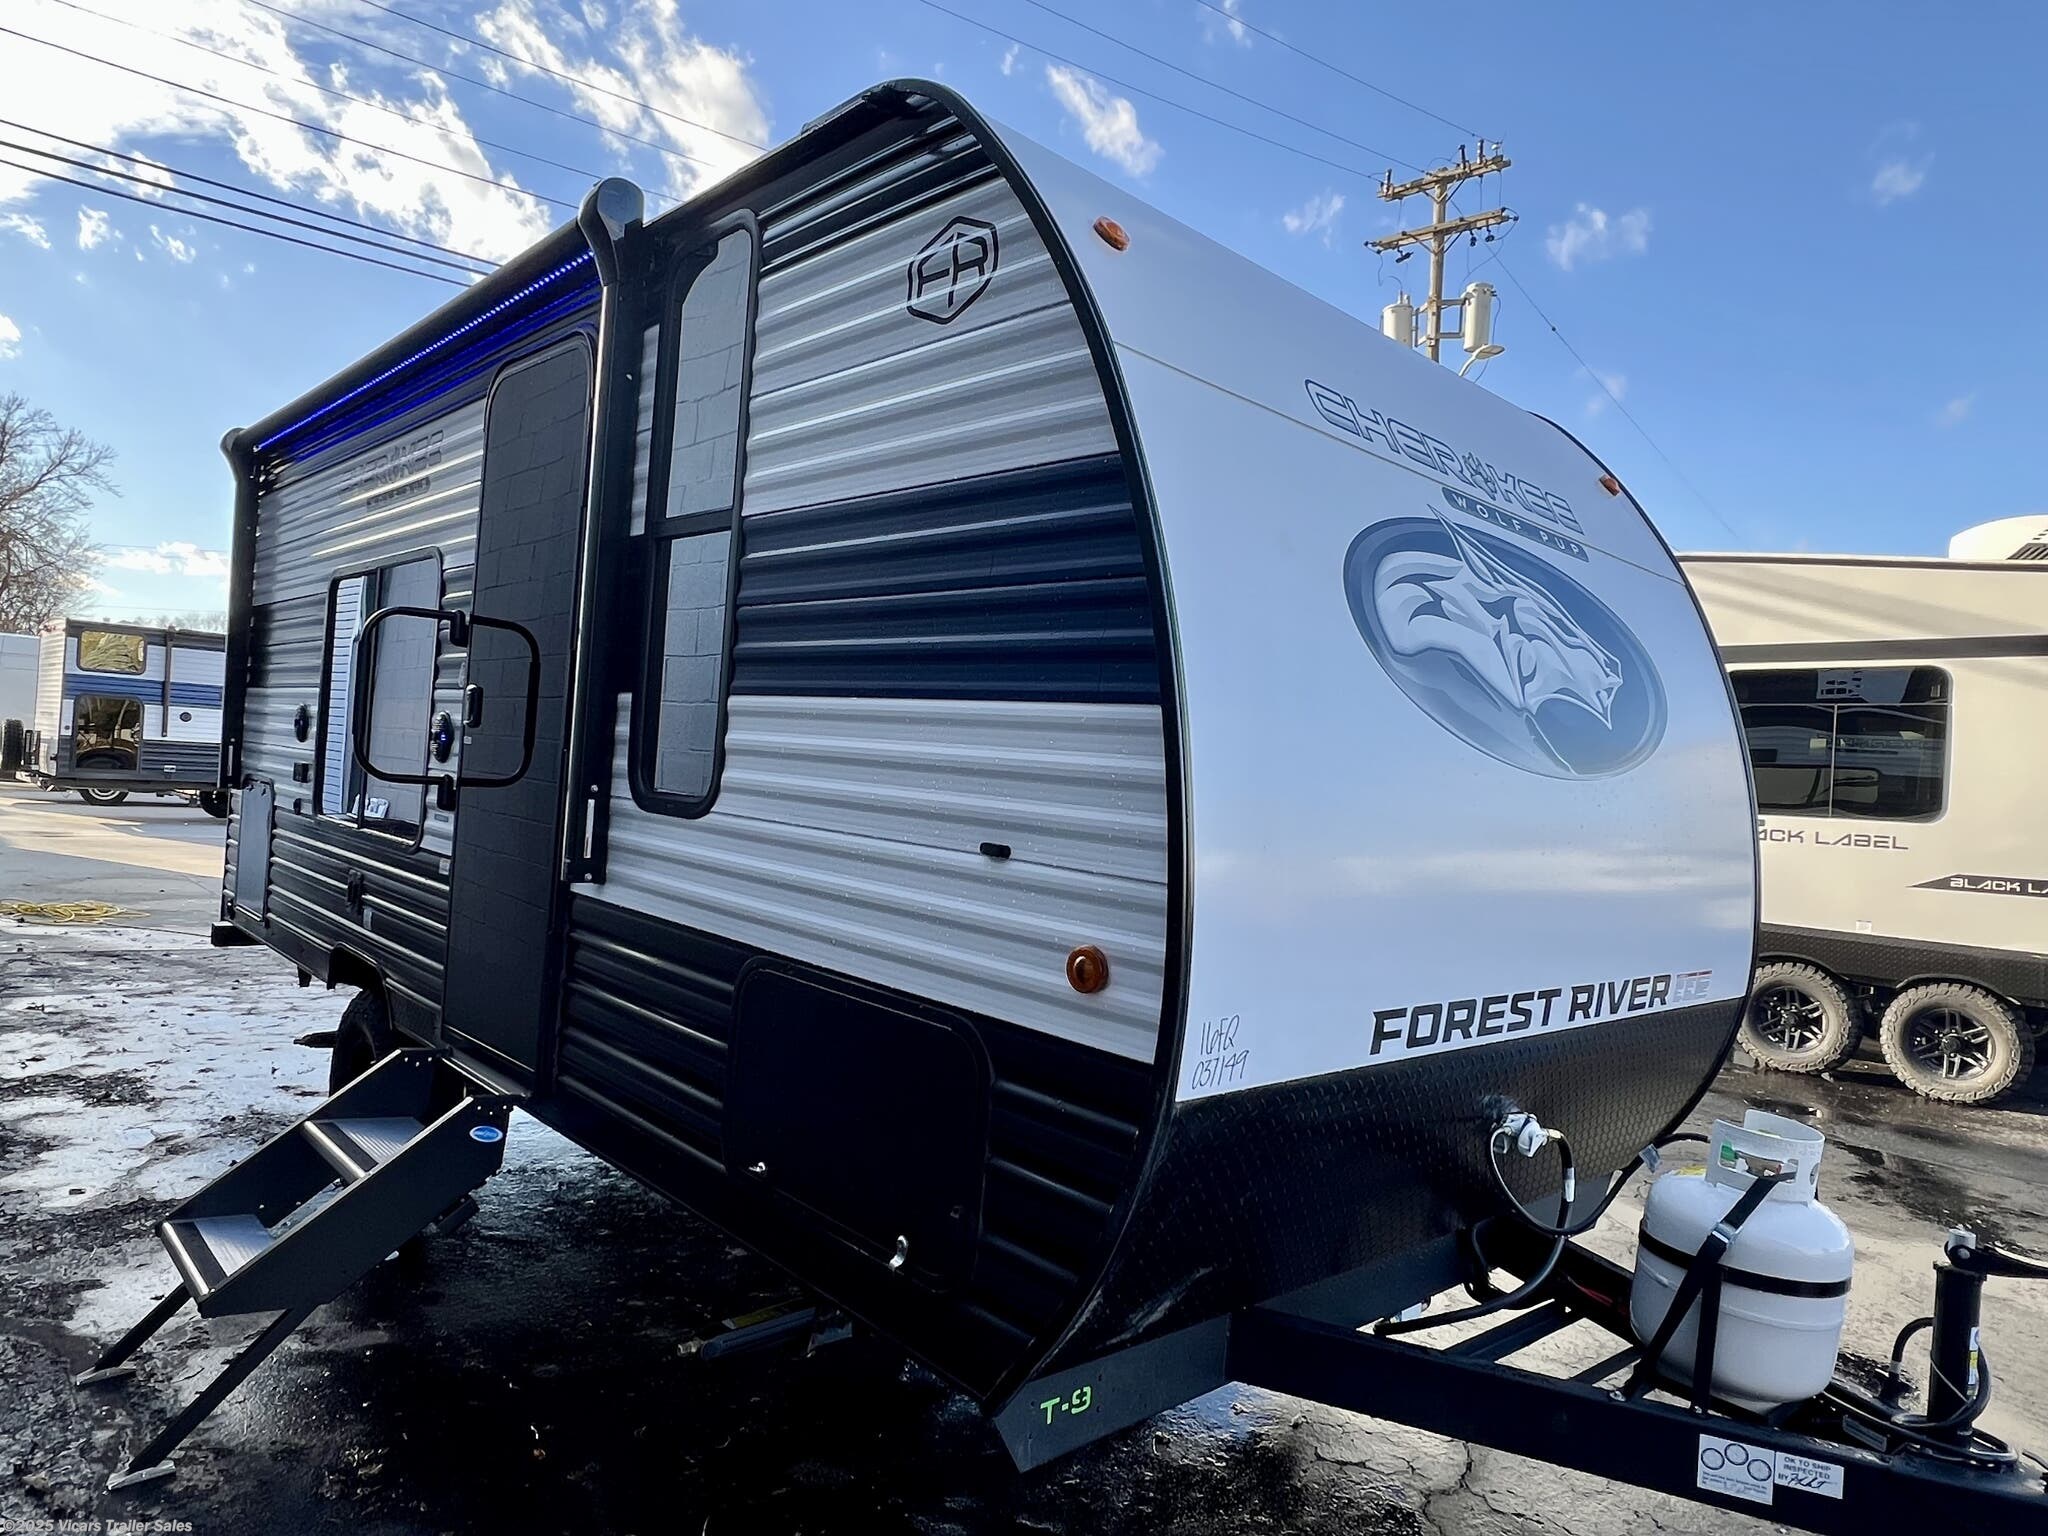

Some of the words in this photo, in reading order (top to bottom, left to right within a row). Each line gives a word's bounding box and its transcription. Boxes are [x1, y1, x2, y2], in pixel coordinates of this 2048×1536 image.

[1451, 492, 1522, 532] WOLF
[1539, 530, 1580, 556] PUP
[1815, 831, 1909, 851] LABEL
[1949, 877, 2021, 892] BLACK
[1369, 987, 1563, 1056] FOREST
[1568, 974, 1672, 1023] RIVER
[1783, 1463, 1831, 1480] INSPECTED
[1784, 1456, 1796, 1464] OK
[1798, 1458, 1810, 1468] TO
[1812, 1462, 1831, 1472] SHIP
